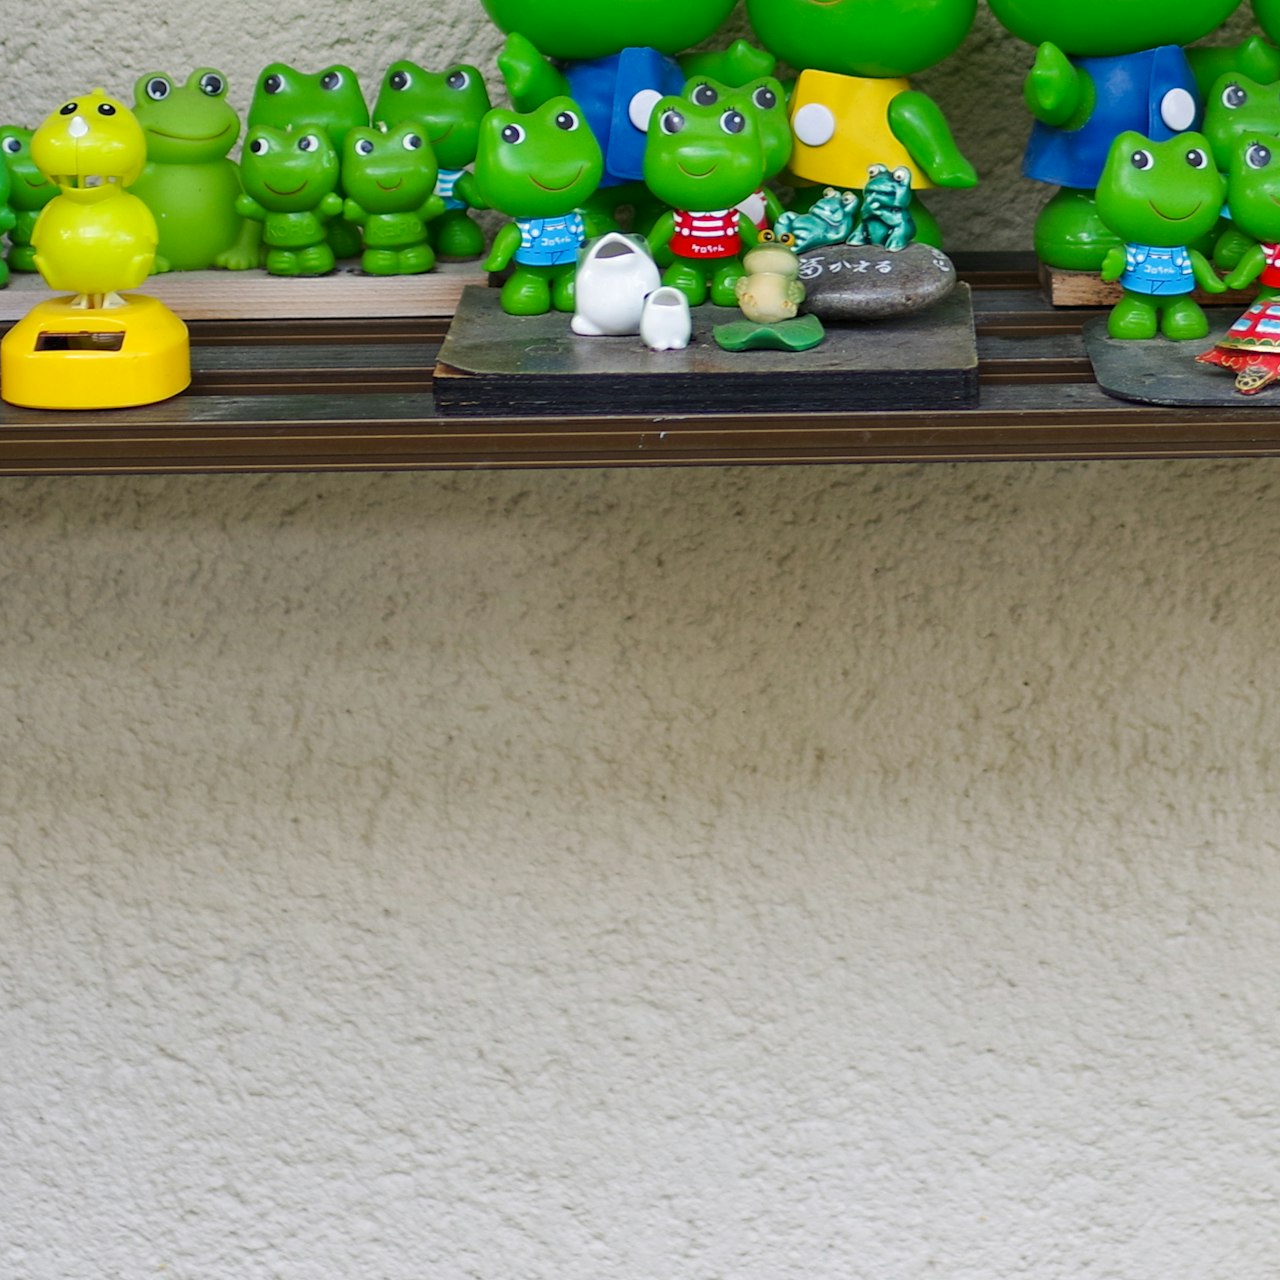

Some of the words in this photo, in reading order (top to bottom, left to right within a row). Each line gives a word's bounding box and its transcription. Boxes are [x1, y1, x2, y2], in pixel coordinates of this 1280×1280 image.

[691, 243, 725, 254] ケロちゃん
